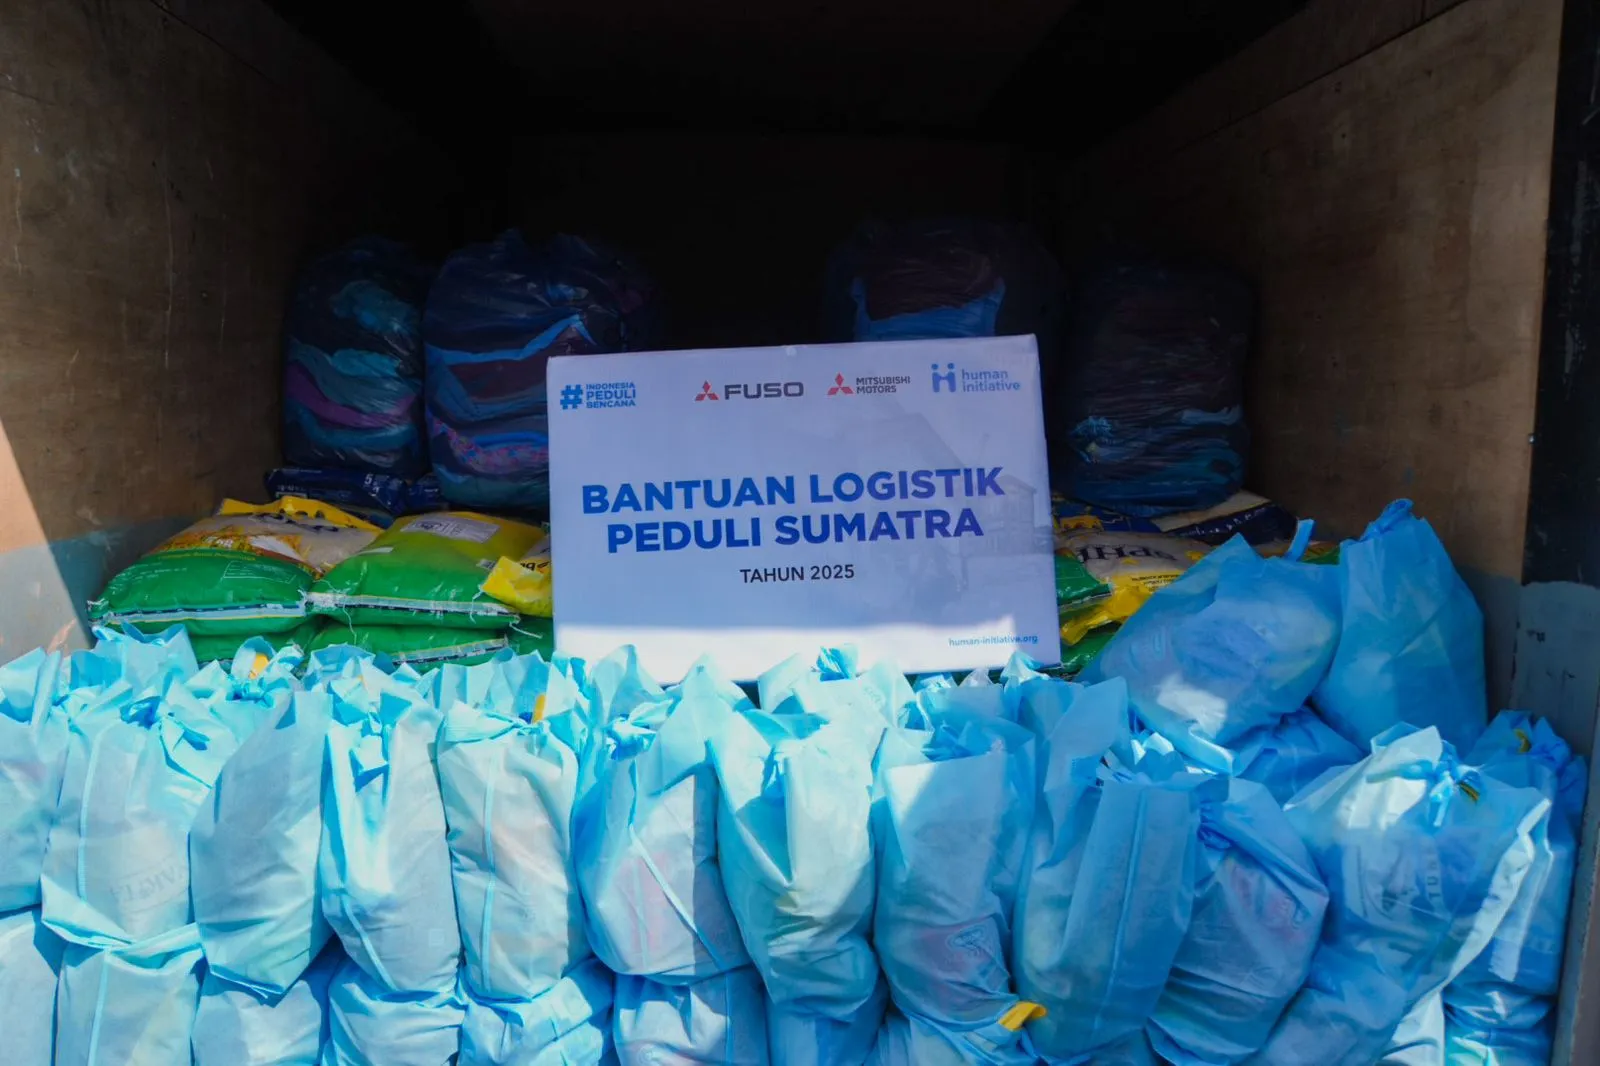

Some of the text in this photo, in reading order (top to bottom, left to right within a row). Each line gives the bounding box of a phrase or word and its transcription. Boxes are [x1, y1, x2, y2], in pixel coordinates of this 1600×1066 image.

[855, 376, 911, 386] MITSUBISHI
[962, 368, 1008, 381] human
[586, 382, 636, 390] INDONESIA
[724, 381, 804, 400] FUSO
[856, 385, 897, 395] MOTORS
[962, 380, 1021, 393] initiative
[586, 389, 636, 400] PEDULI
[582, 467, 1005, 514] BANTUAN LOGISTIK
[607, 507, 984, 554] PEDULI SUMATRA
[739, 564, 855, 584] TAHUN 2025
[948, 634, 1039, 648] human-initiative.org
